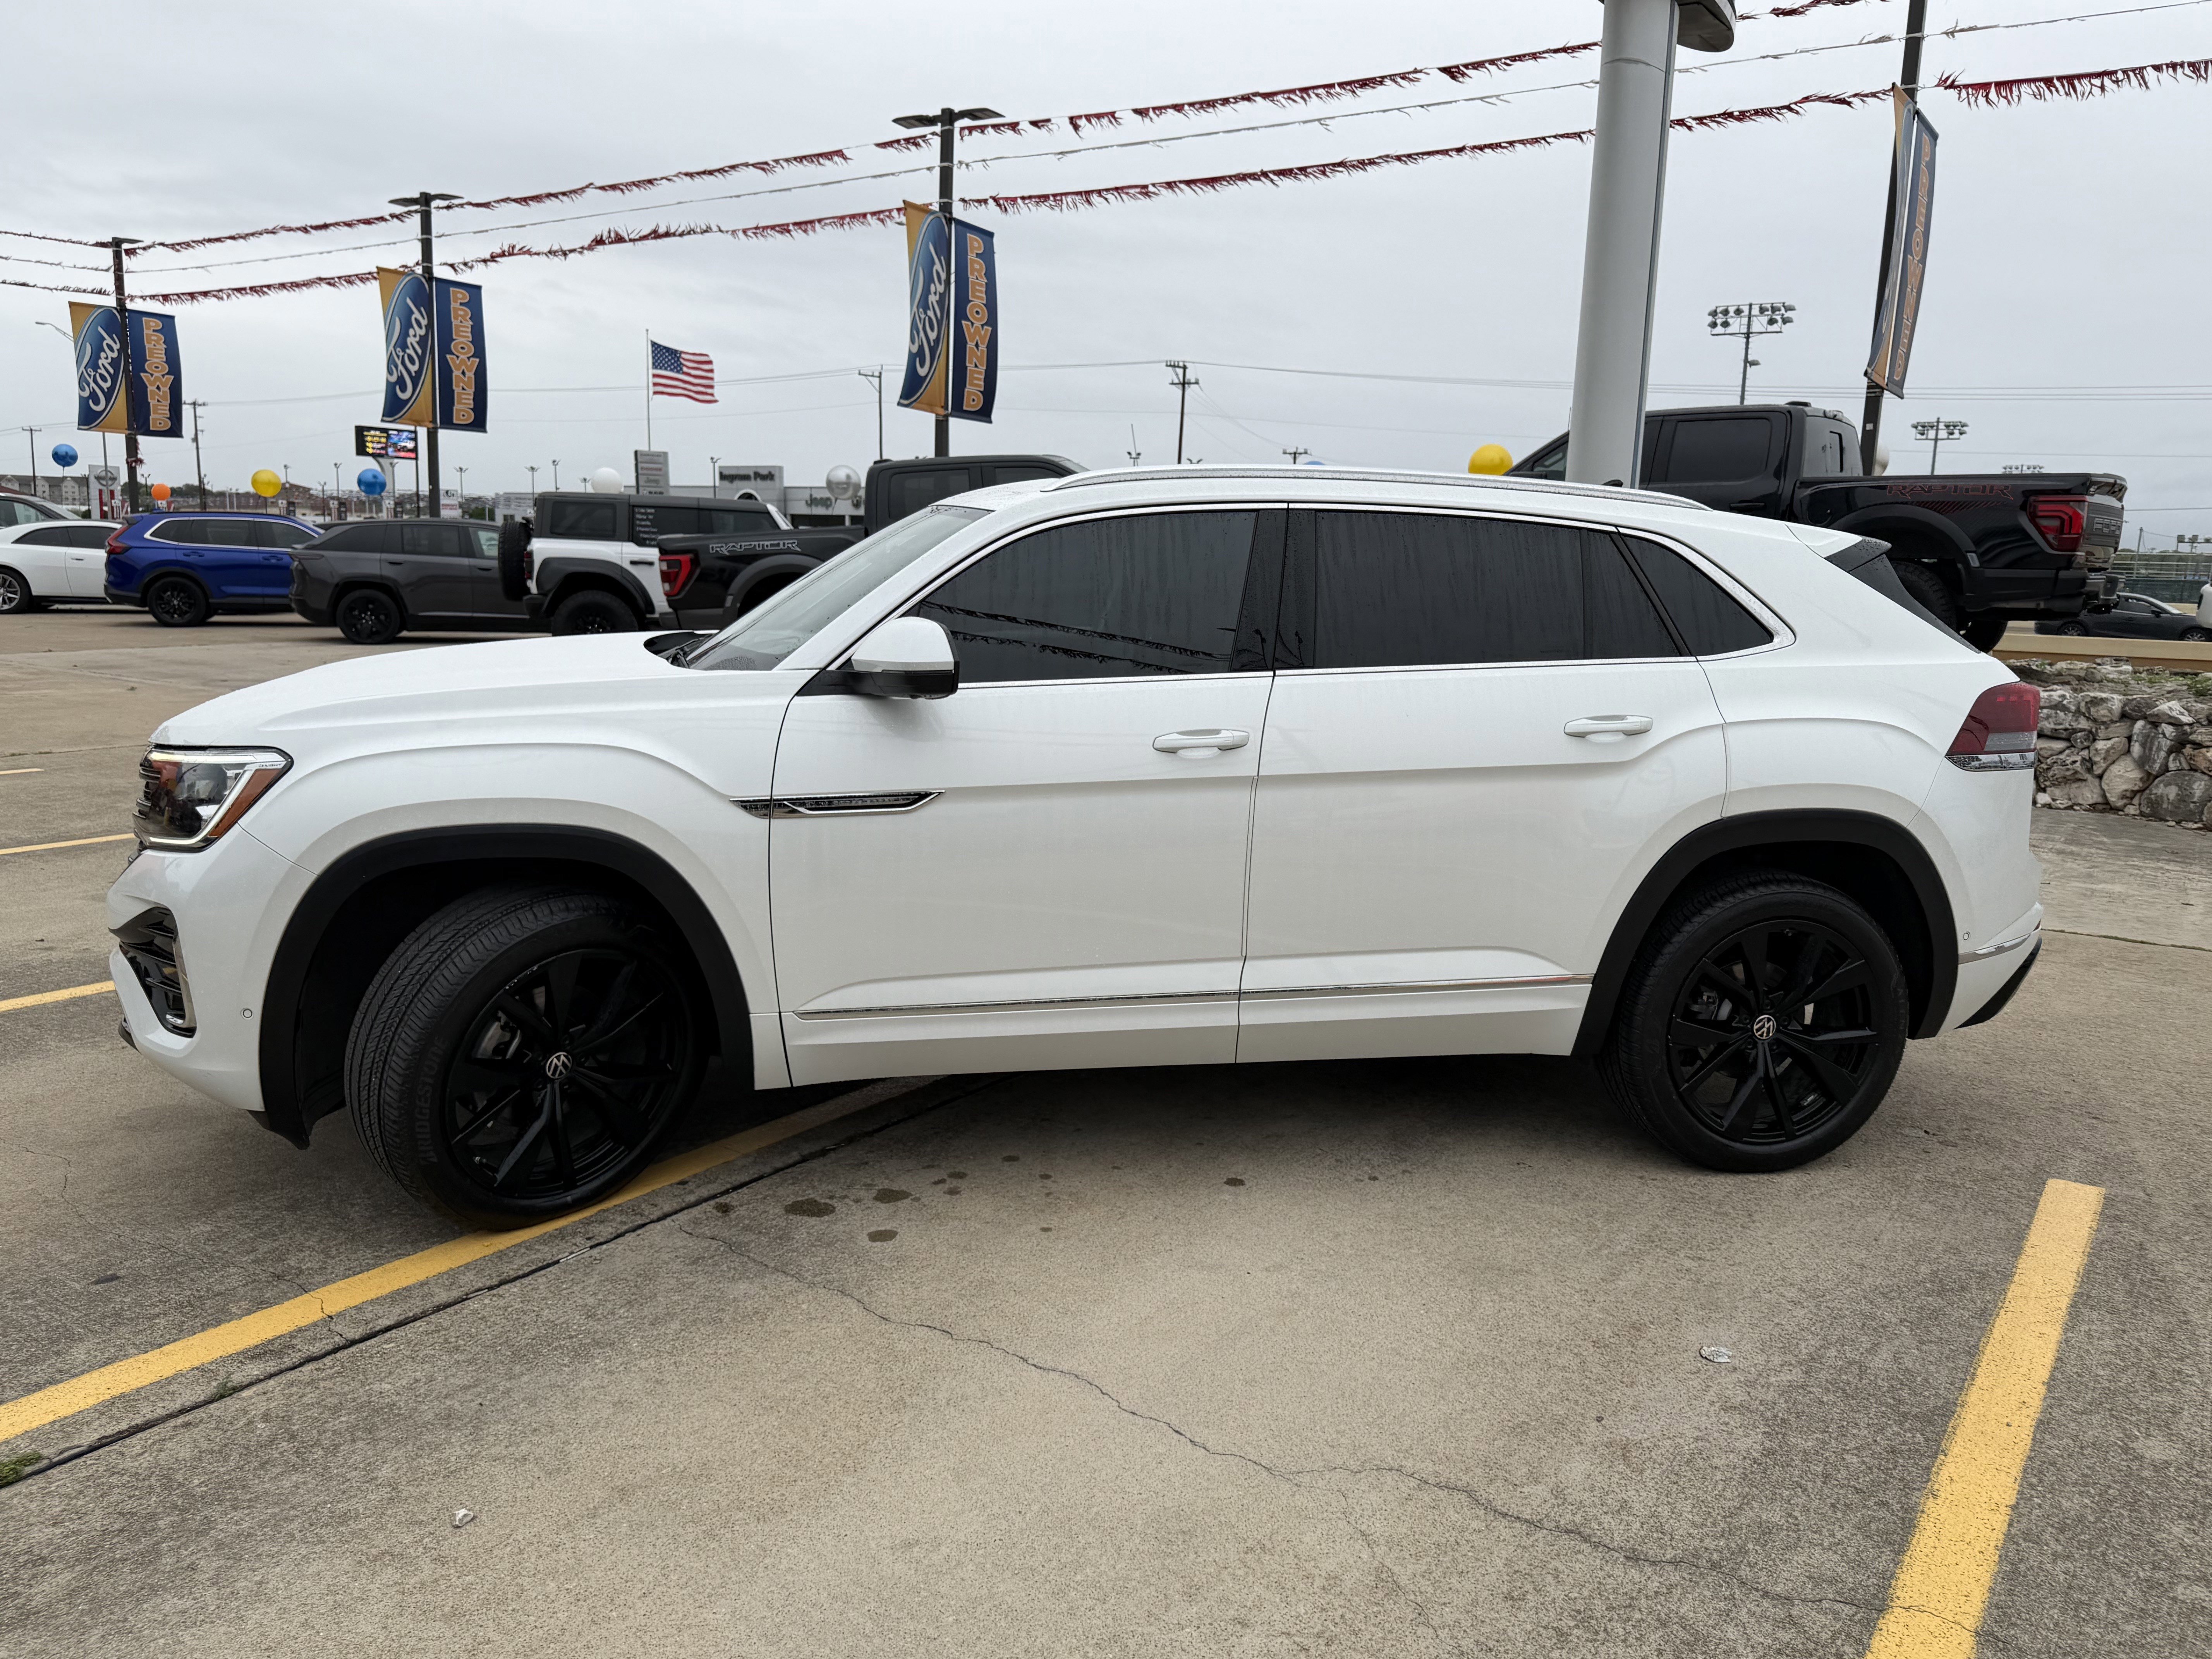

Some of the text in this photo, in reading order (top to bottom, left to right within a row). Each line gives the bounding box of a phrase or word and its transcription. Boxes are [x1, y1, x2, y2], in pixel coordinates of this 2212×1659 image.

[1894, 132, 1931, 381] PREOWNED
[387, 297, 428, 400] Ford
[446, 288, 480, 424] PREOWNED
[909, 242, 947, 377] Ford
[962, 233, 992, 412] PREOWNED
[78, 325, 120, 412] Ford
[140, 317, 174, 431] PREOWNED
[754, 471, 775, 482] Park
[1887, 484, 2014, 500] RAPTOR
[2093, 517, 2122, 535] FORD
[709, 539, 802, 556] RAPTOR
